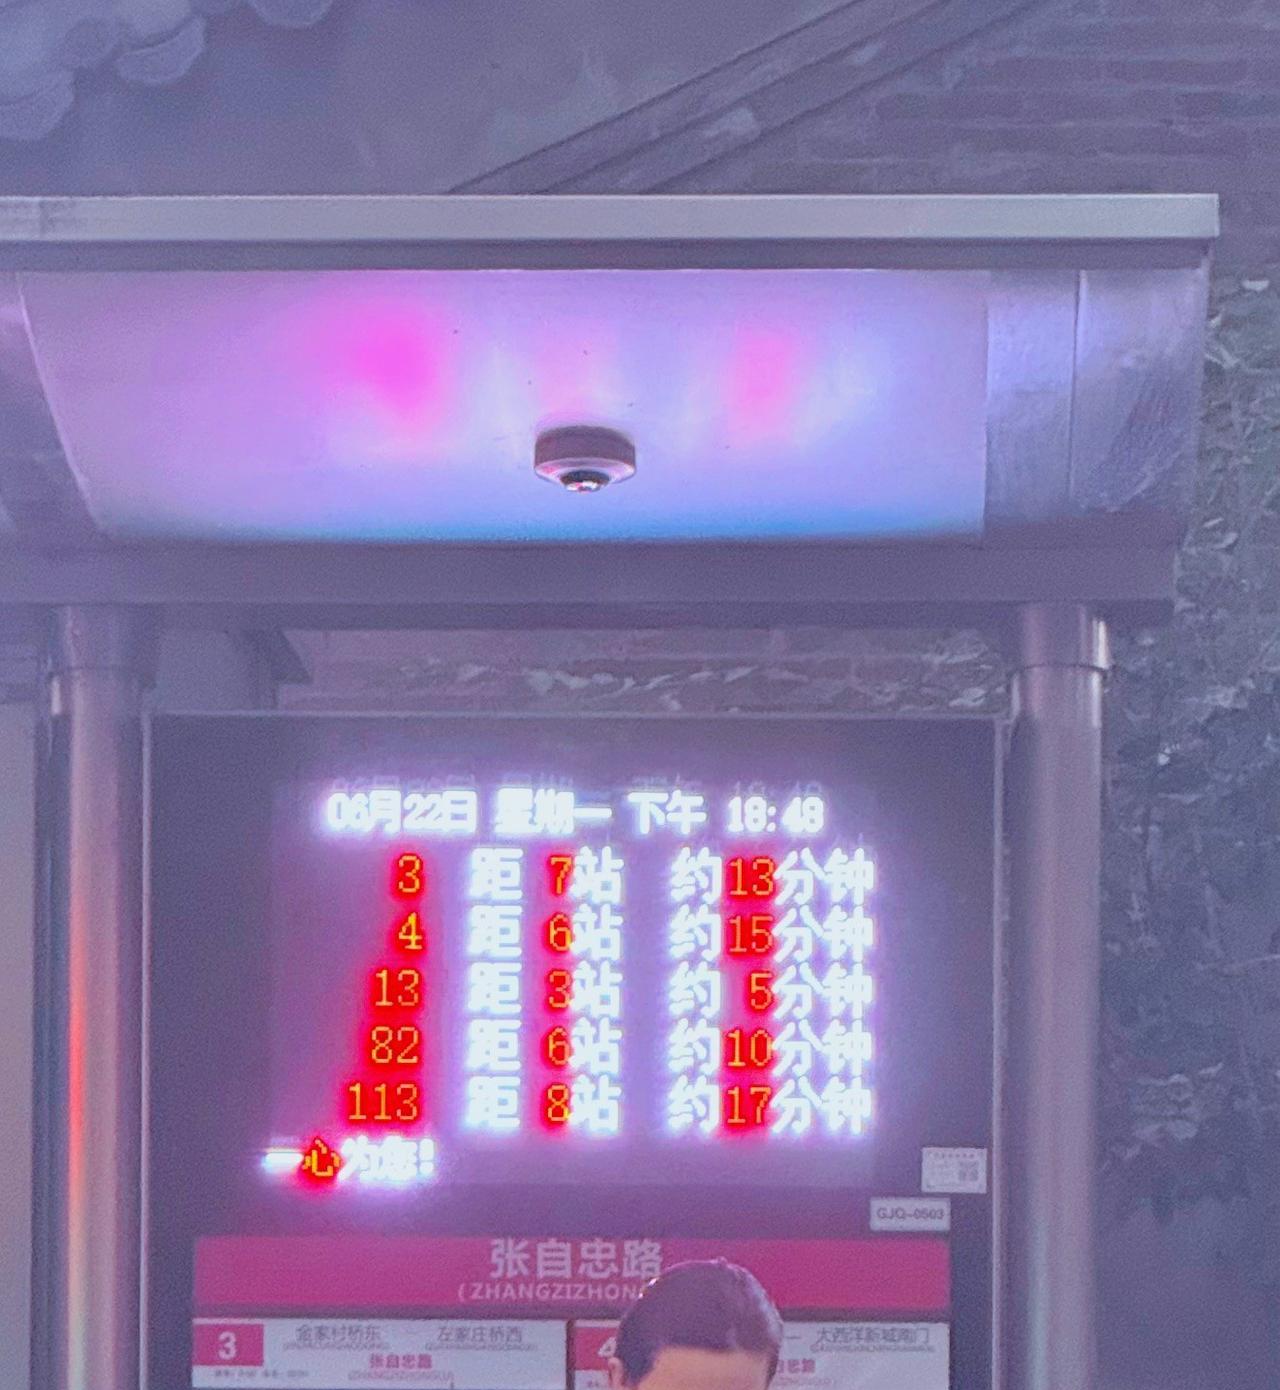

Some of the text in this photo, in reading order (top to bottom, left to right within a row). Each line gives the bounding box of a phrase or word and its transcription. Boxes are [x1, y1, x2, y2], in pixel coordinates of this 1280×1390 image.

[328, 788, 824, 834] 06月22日 星期一 下午 18:48
[398, 846, 875, 904] 3 距 7站 约13分钟
[398, 903, 874, 963] 4 距 6站 约15分钟
[375, 969, 420, 1007] 13
[467, 961, 522, 1014] 距
[548, 960, 623, 1018] 3站
[371, 1017, 872, 1077] 82 距 6站 约10分钟
[348, 1074, 871, 1134] 113 距 8站 约17分钟
[490, 1237, 663, 1279] 张自忠路
[458, 1283, 642, 1302] (ZHANGZIZHON
[218, 1331, 238, 1360] 3
[370, 1353, 433, 1369] 张自忠路
